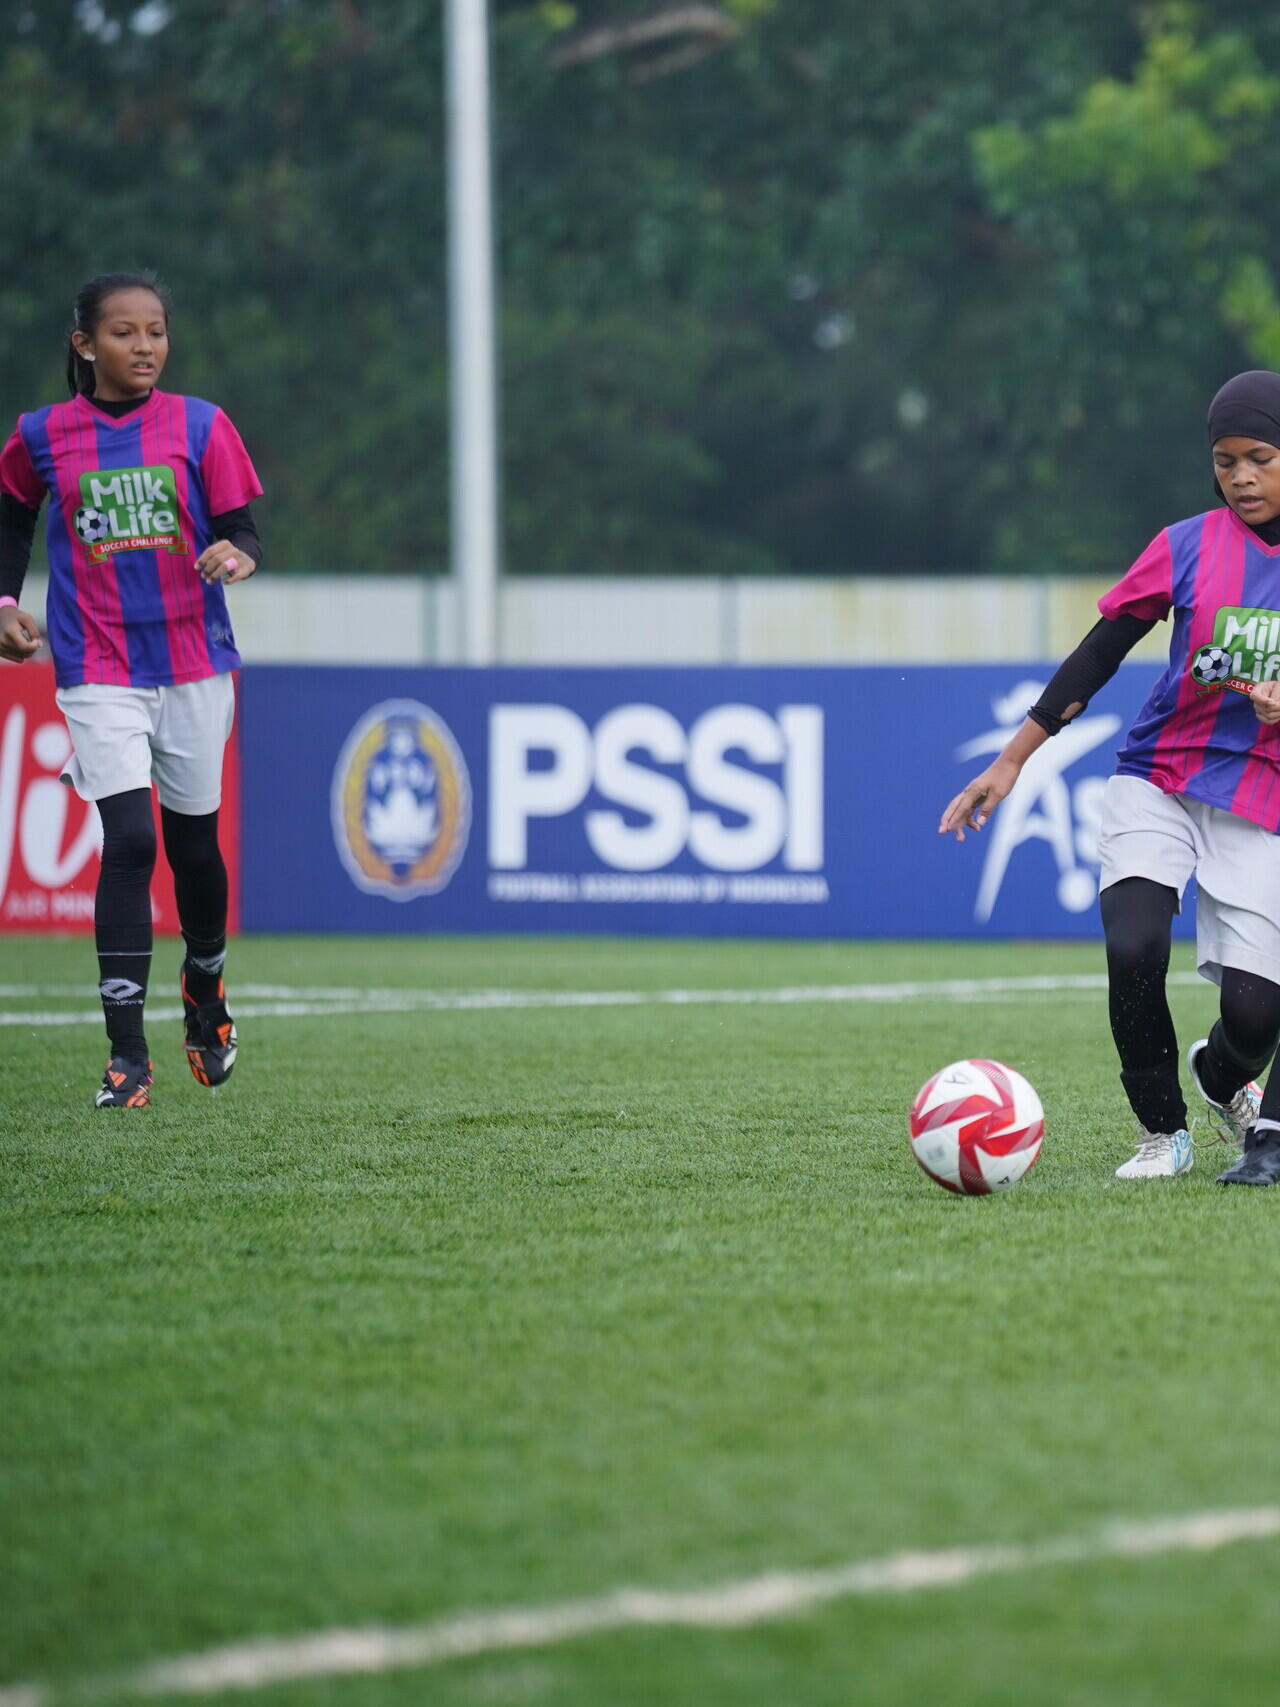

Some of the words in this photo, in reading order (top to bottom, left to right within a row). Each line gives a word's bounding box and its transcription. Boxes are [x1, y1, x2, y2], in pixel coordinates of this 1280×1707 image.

[90, 471, 169, 507] Milk
[108, 503, 175, 538] Life
[100, 541, 130, 553] SOCCER
[131, 537, 174, 548] CHALLENGE
[488, 703, 825, 872] PSSI
